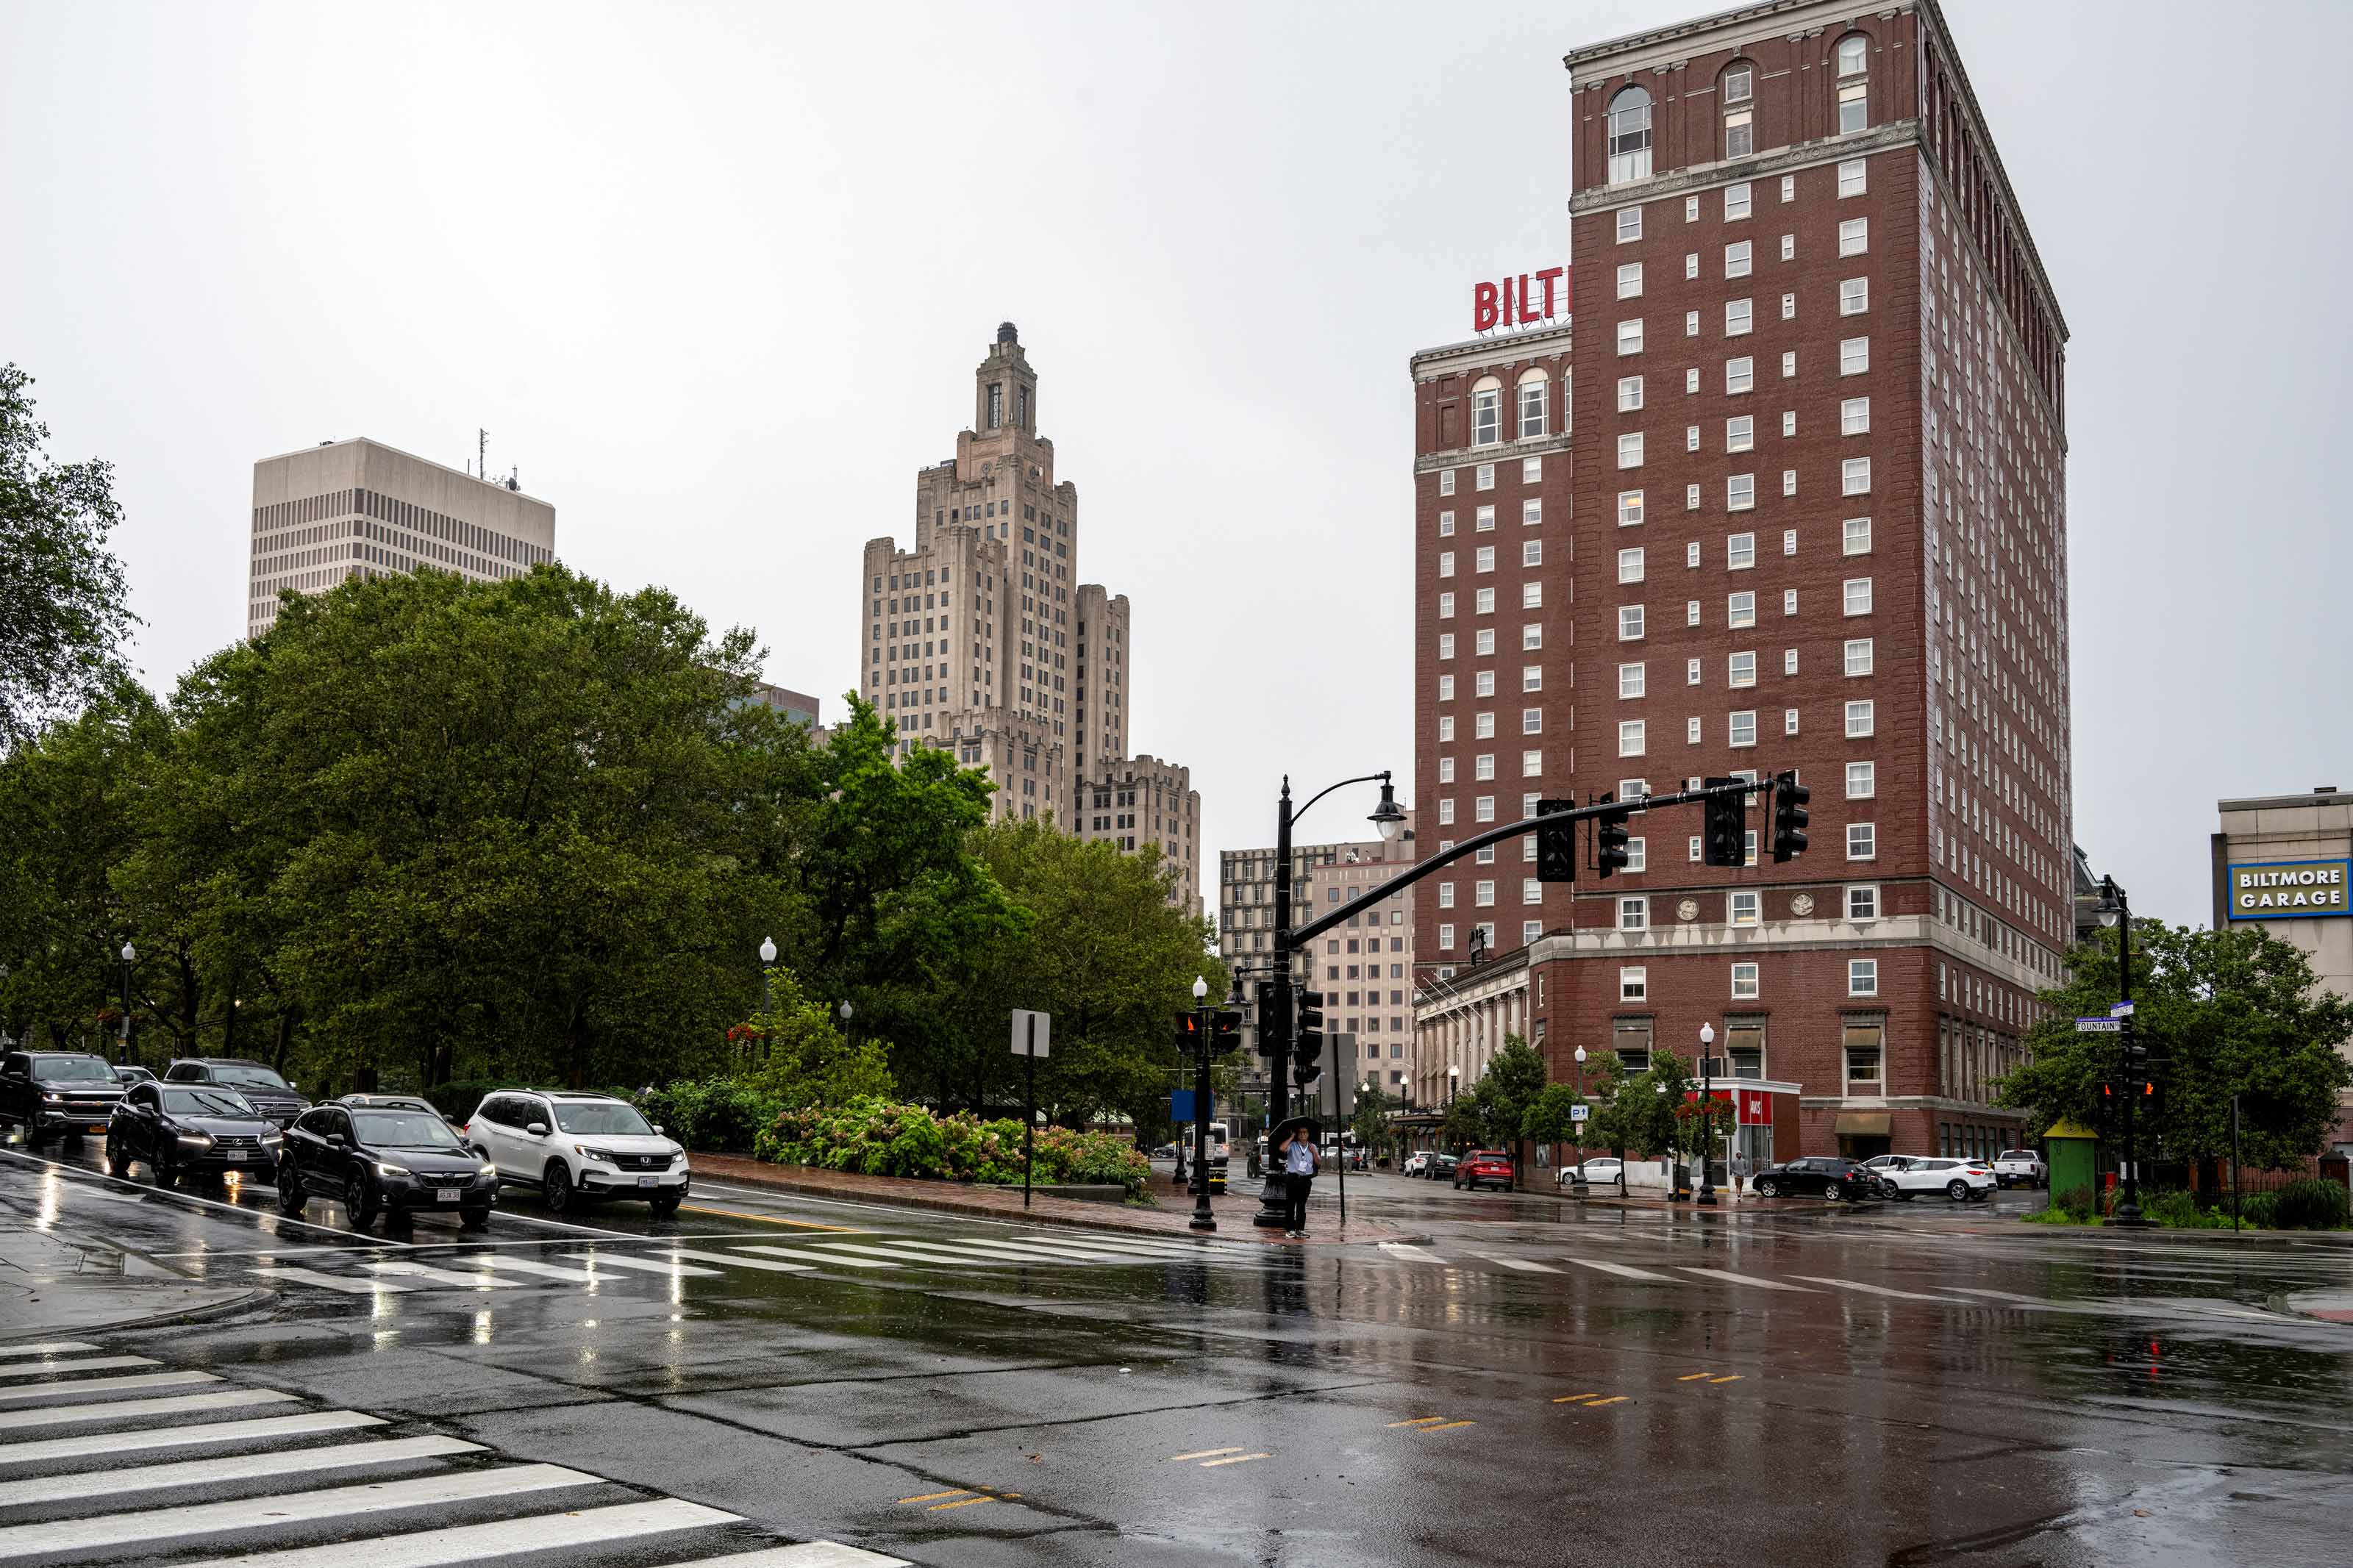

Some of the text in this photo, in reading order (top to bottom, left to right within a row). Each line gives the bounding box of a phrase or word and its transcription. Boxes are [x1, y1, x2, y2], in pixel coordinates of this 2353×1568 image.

[2240, 870, 2341, 888] BILTMORE
[2240, 890, 2340, 908] GARAGE
[2076, 1023, 2115, 1031] FOUNTAIN
[1572, 1109, 1580, 1117] P
[1751, 1100, 1760, 1114] AVIS
